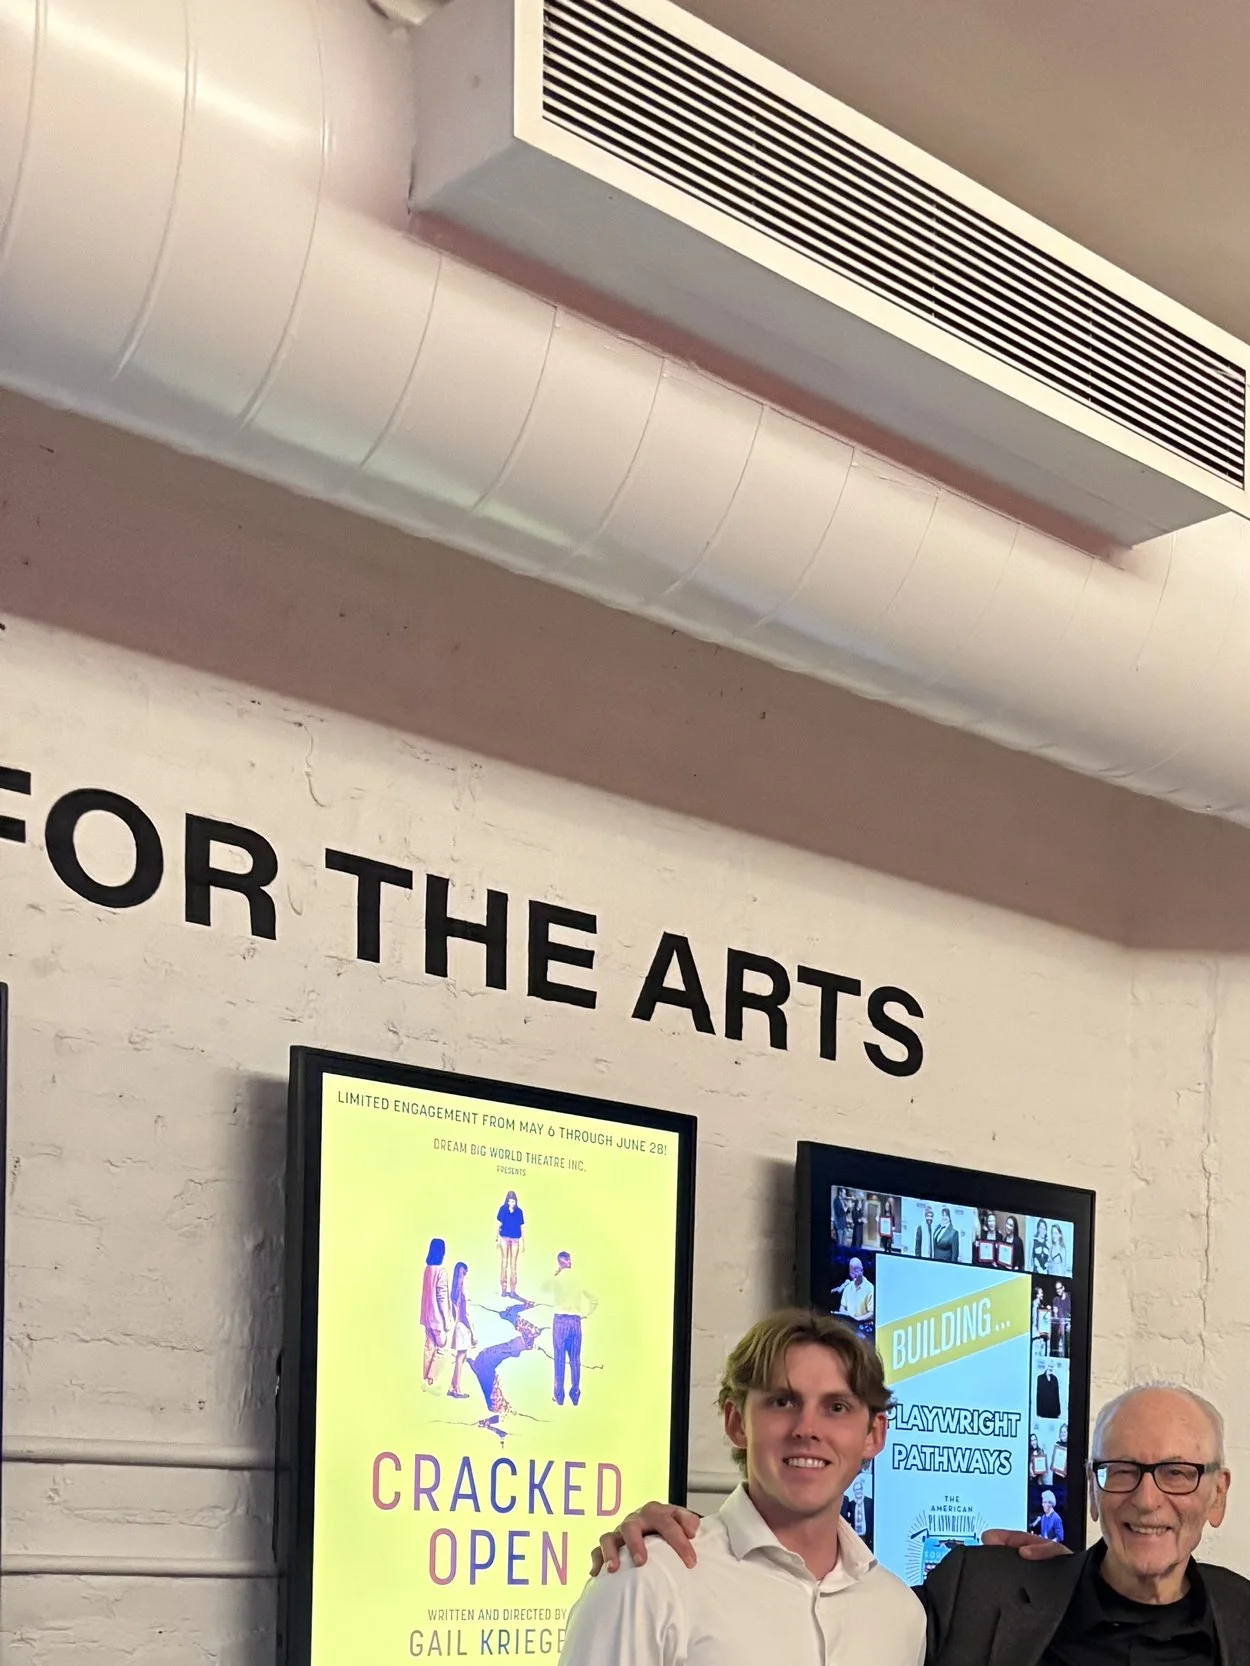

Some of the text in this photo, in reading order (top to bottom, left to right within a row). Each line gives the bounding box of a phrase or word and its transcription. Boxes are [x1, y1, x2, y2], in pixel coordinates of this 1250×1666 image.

[325, 848, 597, 1009] THE
[631, 931, 924, 1077] ARTS
[338, 1091, 668, 1156] LIMITED ENGAGEMENT FROM MAY 6 THROUGH JUNE 28!
[433, 1138, 587, 1172] DREAM BIG WORLD THEATRE INC.
[497, 1165, 526, 1177] PRESENTS
[892, 1443, 1012, 1475] PATHWAYS
[372, 1451, 622, 1516] CRACKED
[945, 1495, 960, 1503] THE
[930, 1505, 973, 1513] AMERICAN
[429, 1528, 568, 1585] OPEN
[428, 1608, 567, 1621] WRITTEN AND DIRECTED BY
[409, 1628, 567, 1657] GAIL KRIEGE
